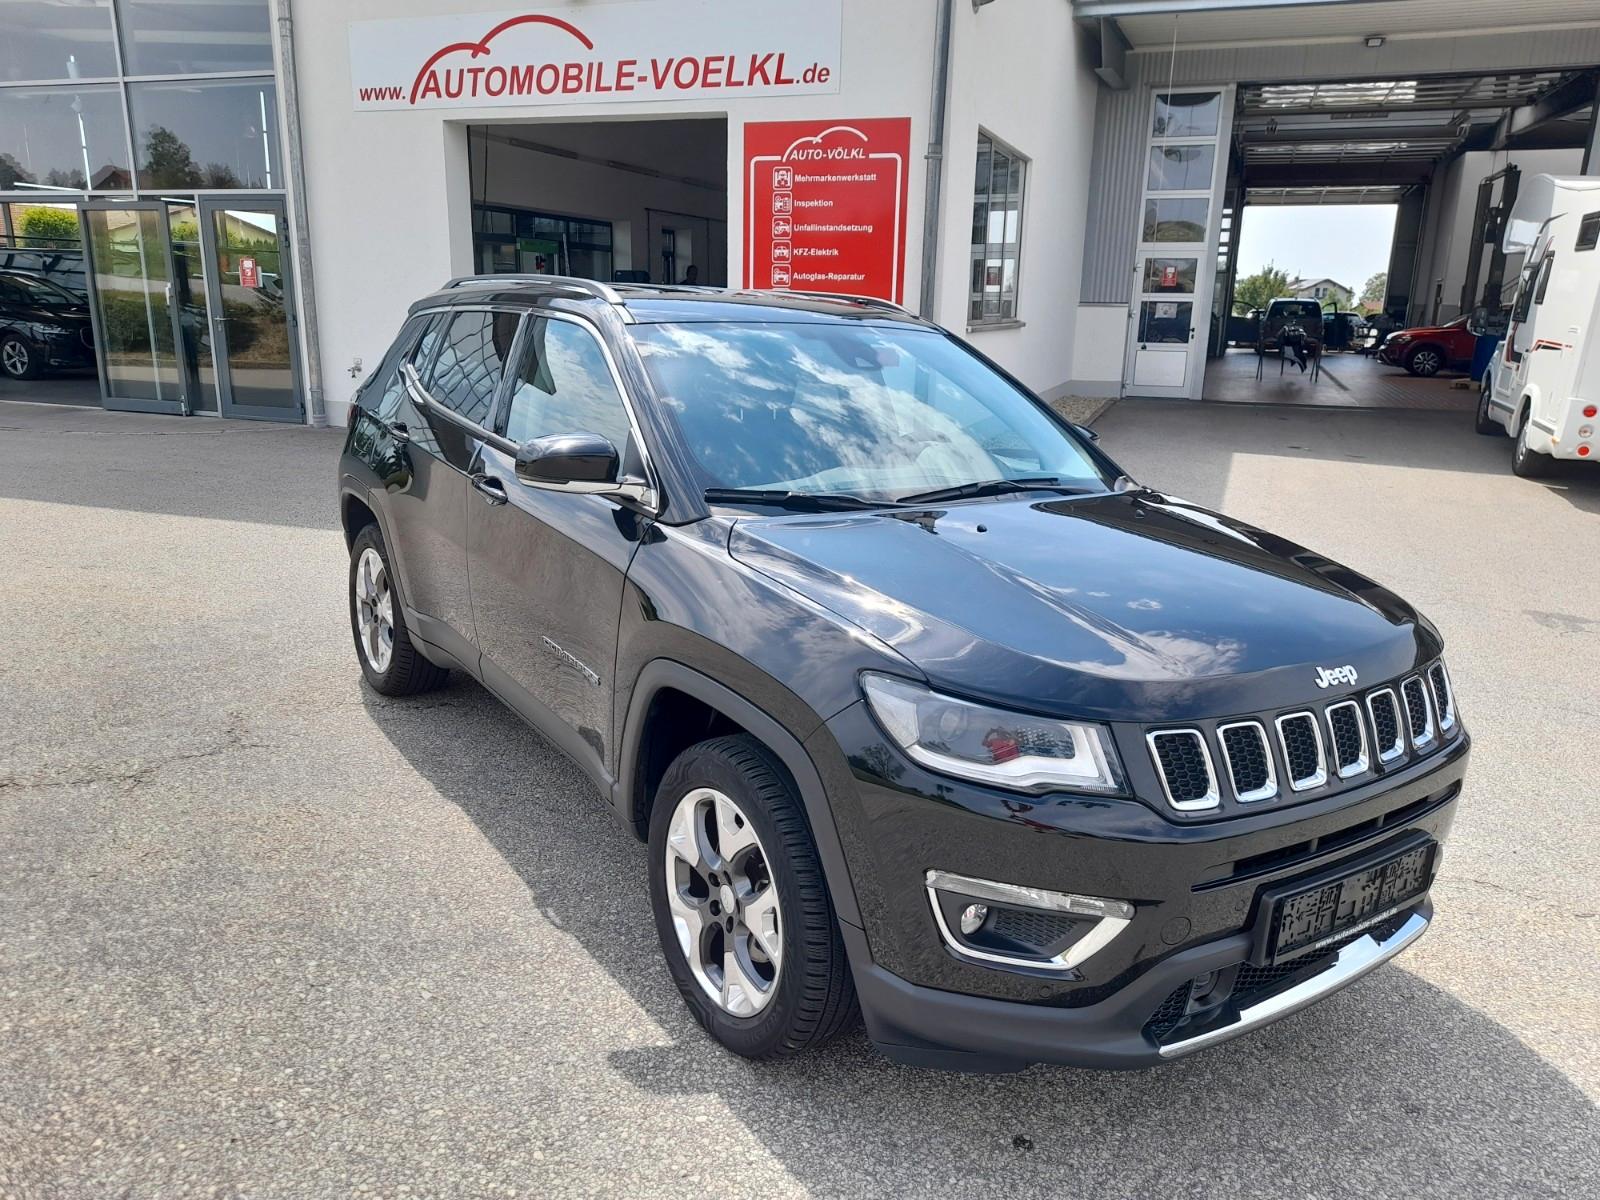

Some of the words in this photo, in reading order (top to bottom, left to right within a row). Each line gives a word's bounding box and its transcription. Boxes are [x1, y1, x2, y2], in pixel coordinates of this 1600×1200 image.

[790, 147, 866, 160] AUTO-VÖLKL
[794, 173, 876, 182] Mehrmarkenwerkstatt
[794, 199, 833, 209] Inspektion
[793, 224, 873, 234] Unfallinstandsetzung
[793, 248, 839, 256] KFZ-Elektrik
[792, 272, 866, 282] Autoglas-Reparatur
[1315, 665, 1358, 688] Jeep
